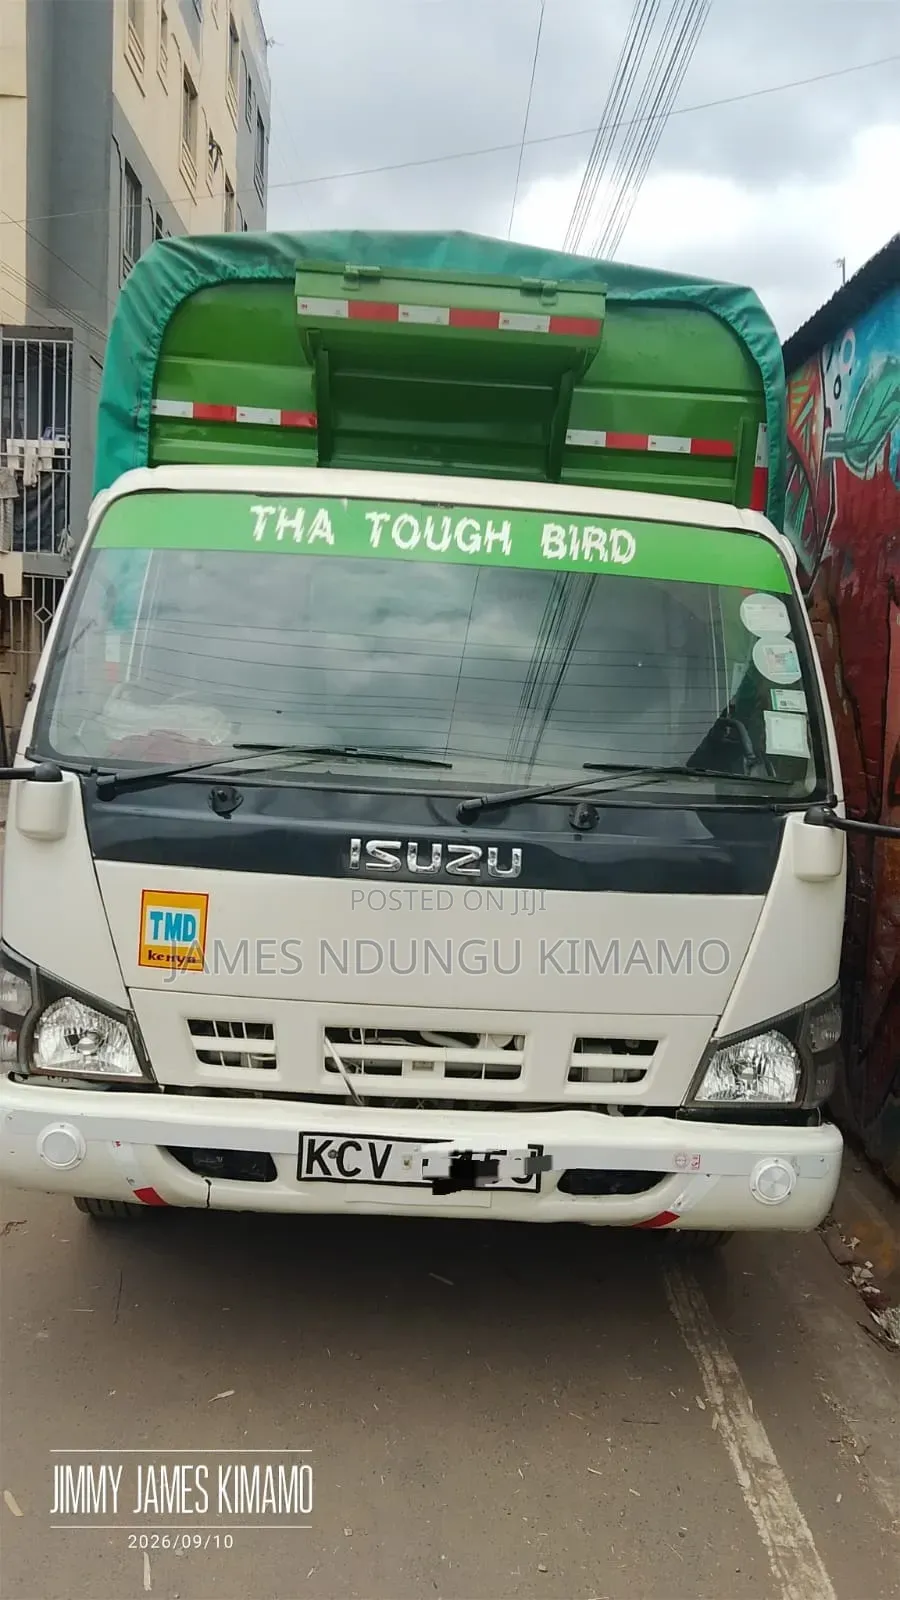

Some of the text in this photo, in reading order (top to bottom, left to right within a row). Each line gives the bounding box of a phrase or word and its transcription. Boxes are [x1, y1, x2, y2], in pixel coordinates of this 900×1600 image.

[250, 504, 637, 565] THA TOUGH BIRD
[349, 838, 523, 879] ISUZU
[150, 911, 197, 942] TMD
[148, 949, 201, 967] kenya
[305, 1138, 393, 1179] KCV
